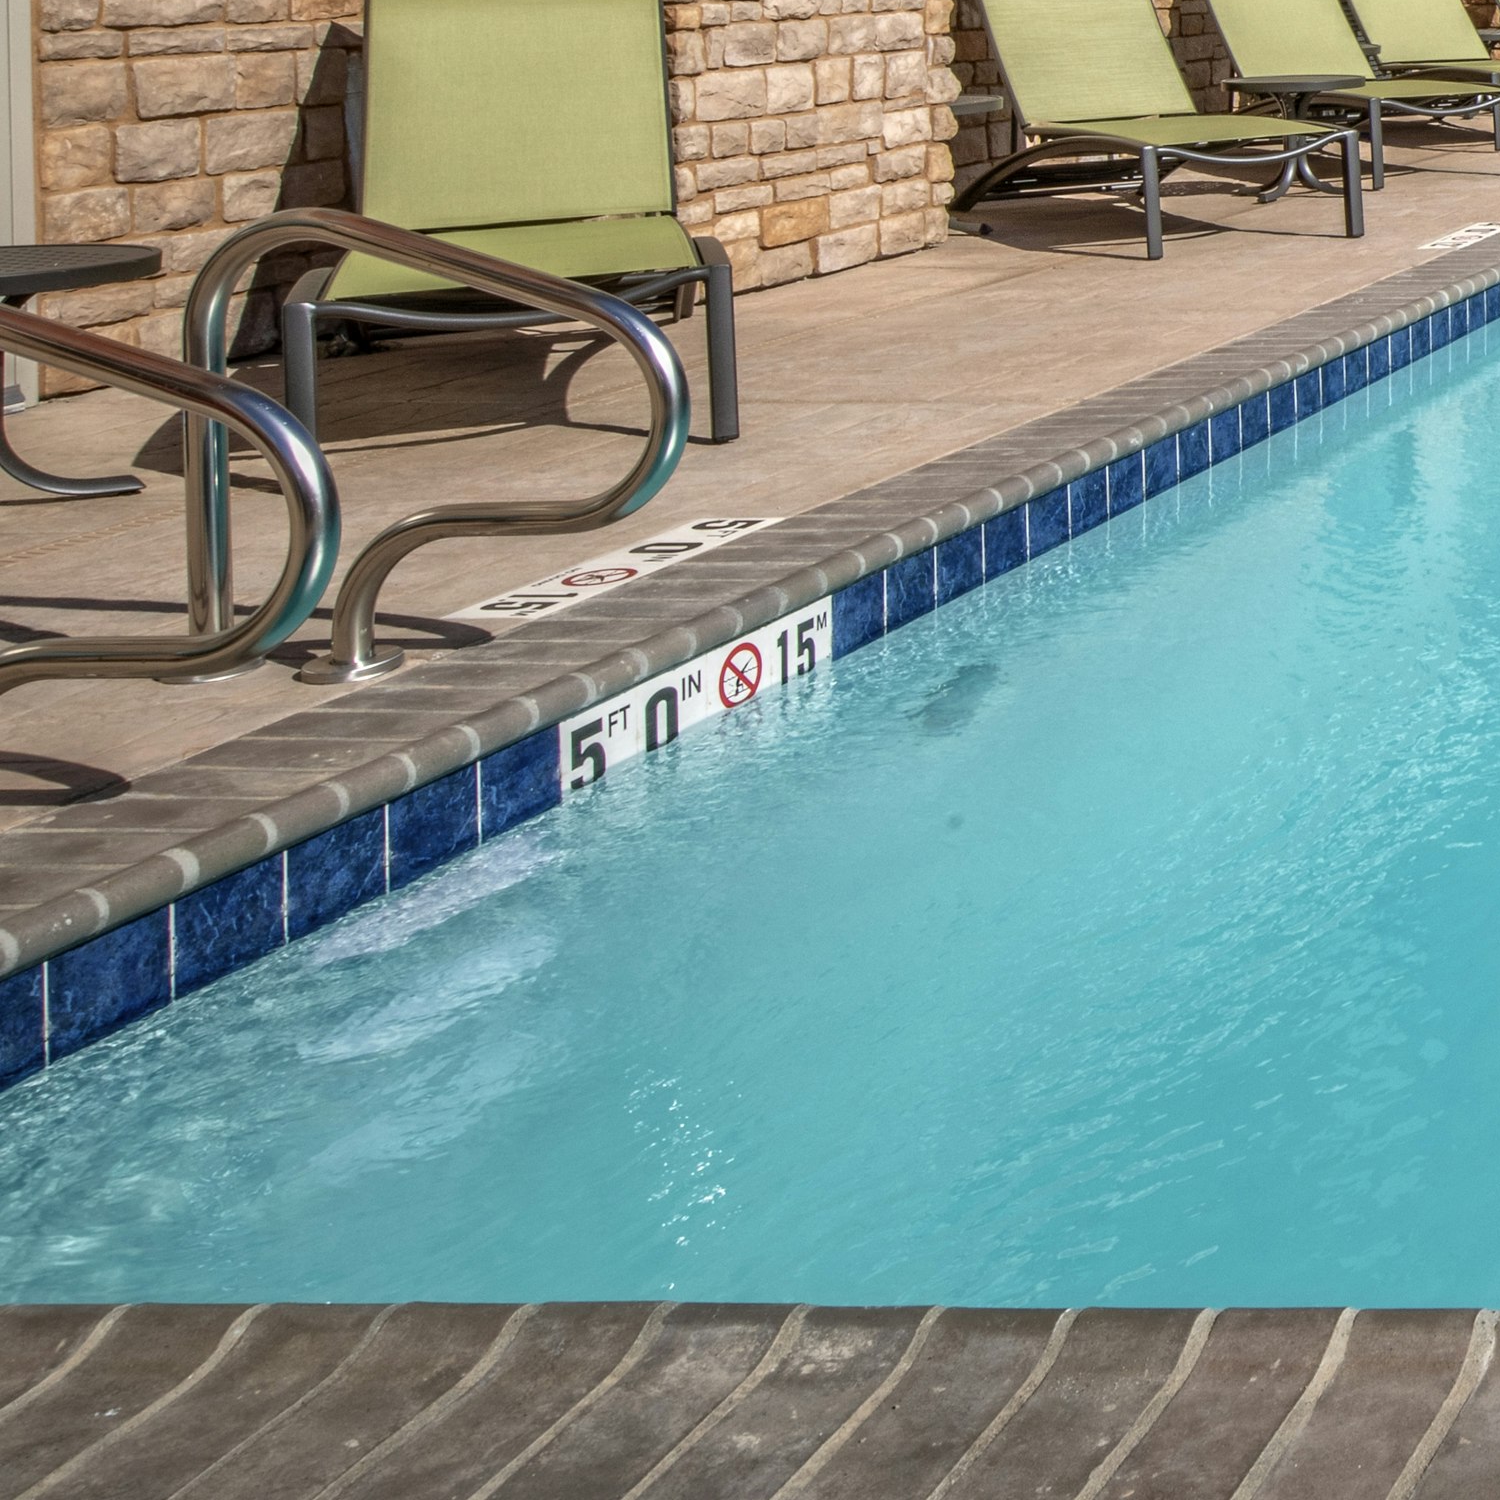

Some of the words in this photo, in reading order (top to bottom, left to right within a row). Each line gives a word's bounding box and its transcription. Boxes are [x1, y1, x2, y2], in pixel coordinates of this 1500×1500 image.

[692, 519, 765, 530] 5
[629, 541, 703, 554] 0
[571, 717, 606, 790] 5
[608, 704, 630, 737] FT
[645, 686, 679, 752] 0
[682, 670, 701, 701] IN
[816, 611, 827, 631] M
